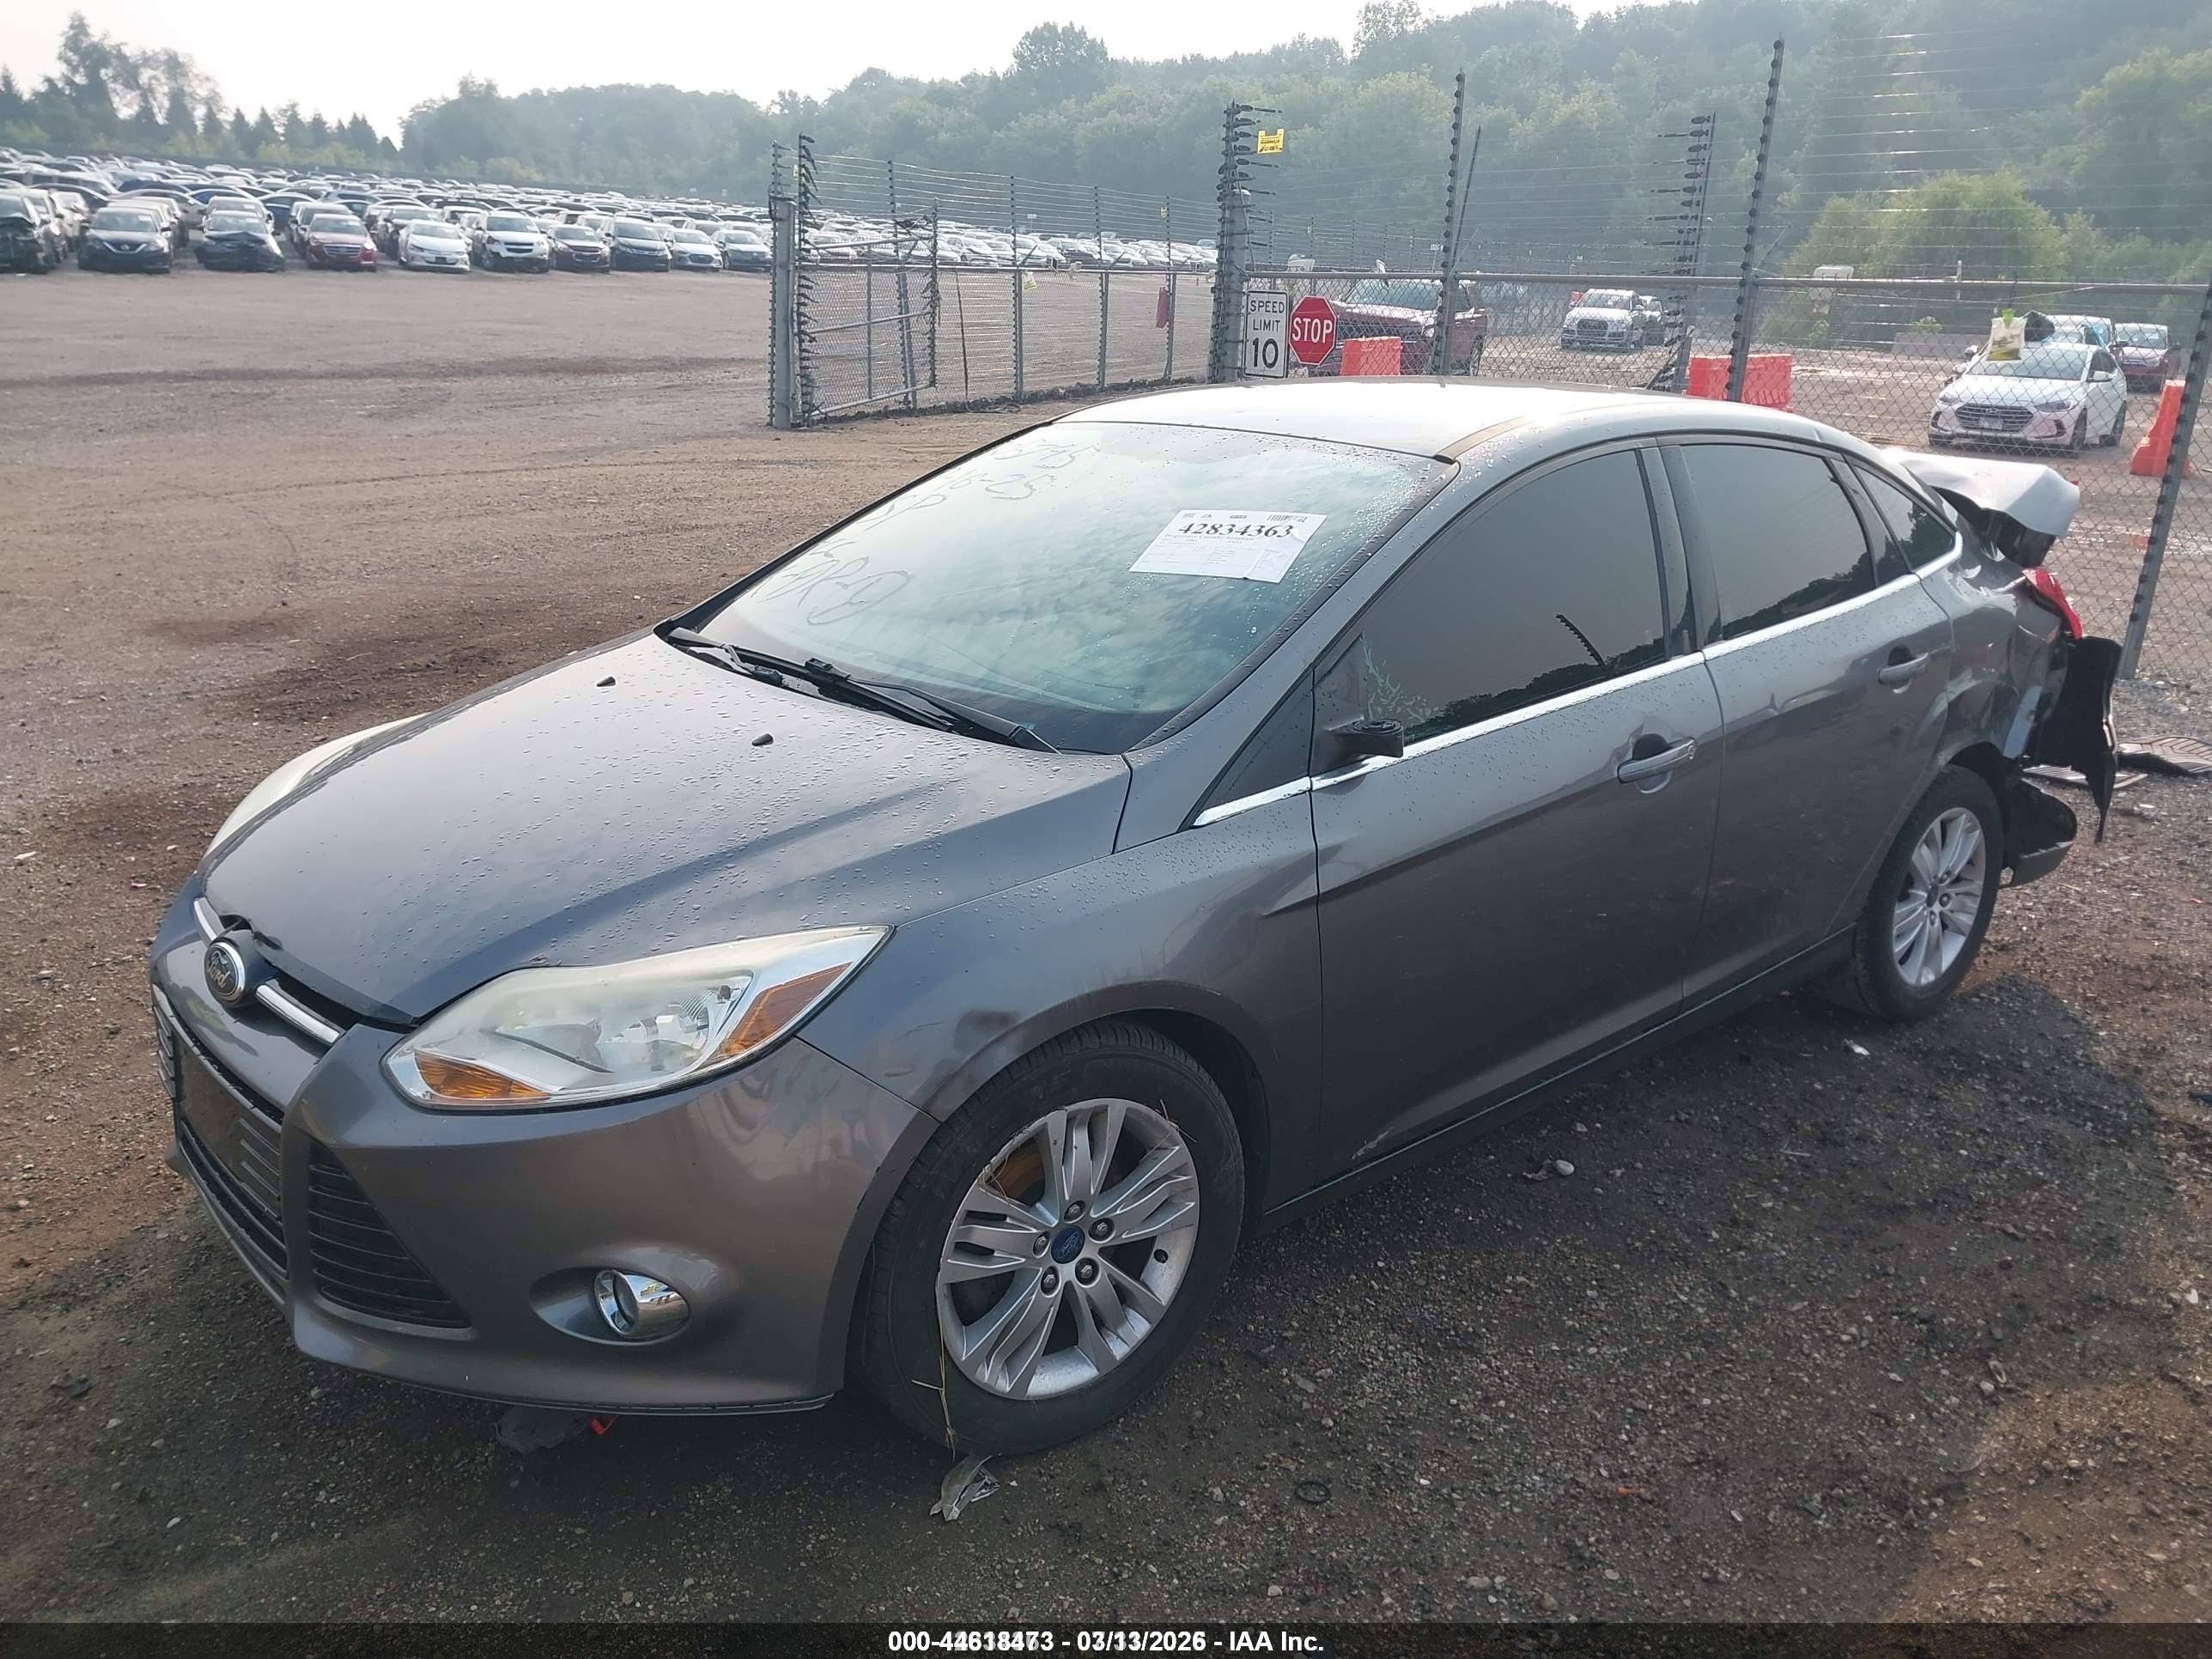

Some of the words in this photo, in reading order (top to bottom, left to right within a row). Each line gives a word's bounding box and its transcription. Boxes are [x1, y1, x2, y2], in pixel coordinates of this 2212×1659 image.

[1249, 300, 1285, 313] SPEED
[1253, 319, 1281, 331] LIMIT
[1291, 317, 1333, 343] STOP
[1252, 337, 1279, 369] 10
[1178, 523, 1293, 538] 42834363
[206, 951, 231, 988] Ford
